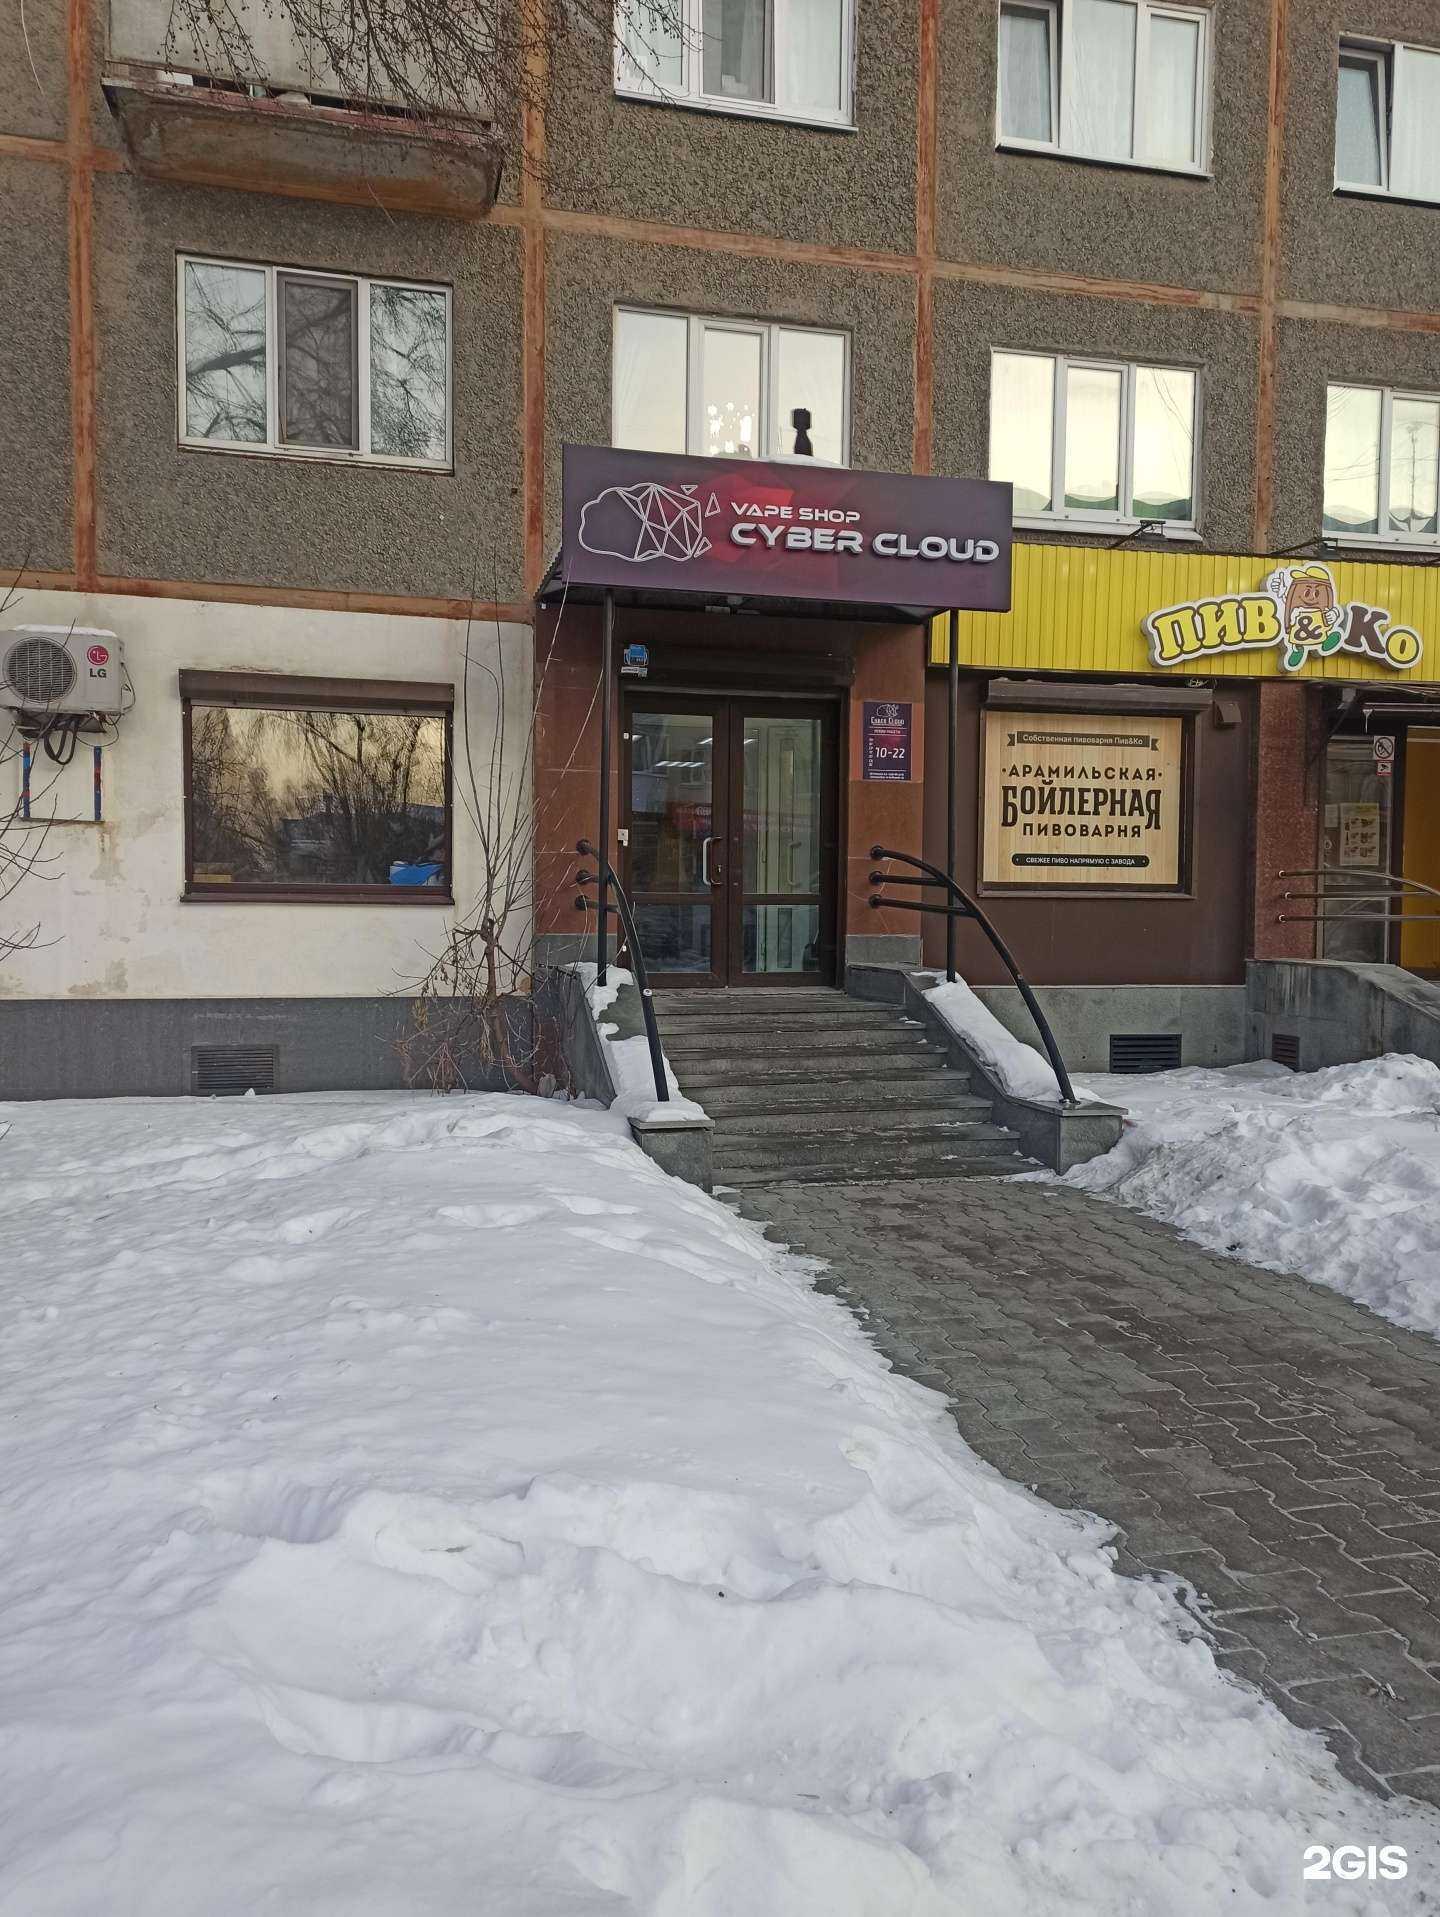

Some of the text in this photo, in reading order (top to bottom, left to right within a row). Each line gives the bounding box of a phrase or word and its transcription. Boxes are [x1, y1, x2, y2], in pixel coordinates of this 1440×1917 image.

[730, 501, 861, 523] VAPE SHOP
[730, 522, 1000, 563] CYBER CLOUD
[89, 668, 107, 678] LG
[1022, 733, 1144, 746] Собственная пивоварня Пив&Ко
[875, 747, 905, 759] 10-22
[1008, 764, 1156, 781] АРАМИЛЬСКАЯ
[1001, 779, 1162, 830] БОЙЛЕРНАЯ
[1022, 823, 1141, 838] ПИВОВАРНЯ
